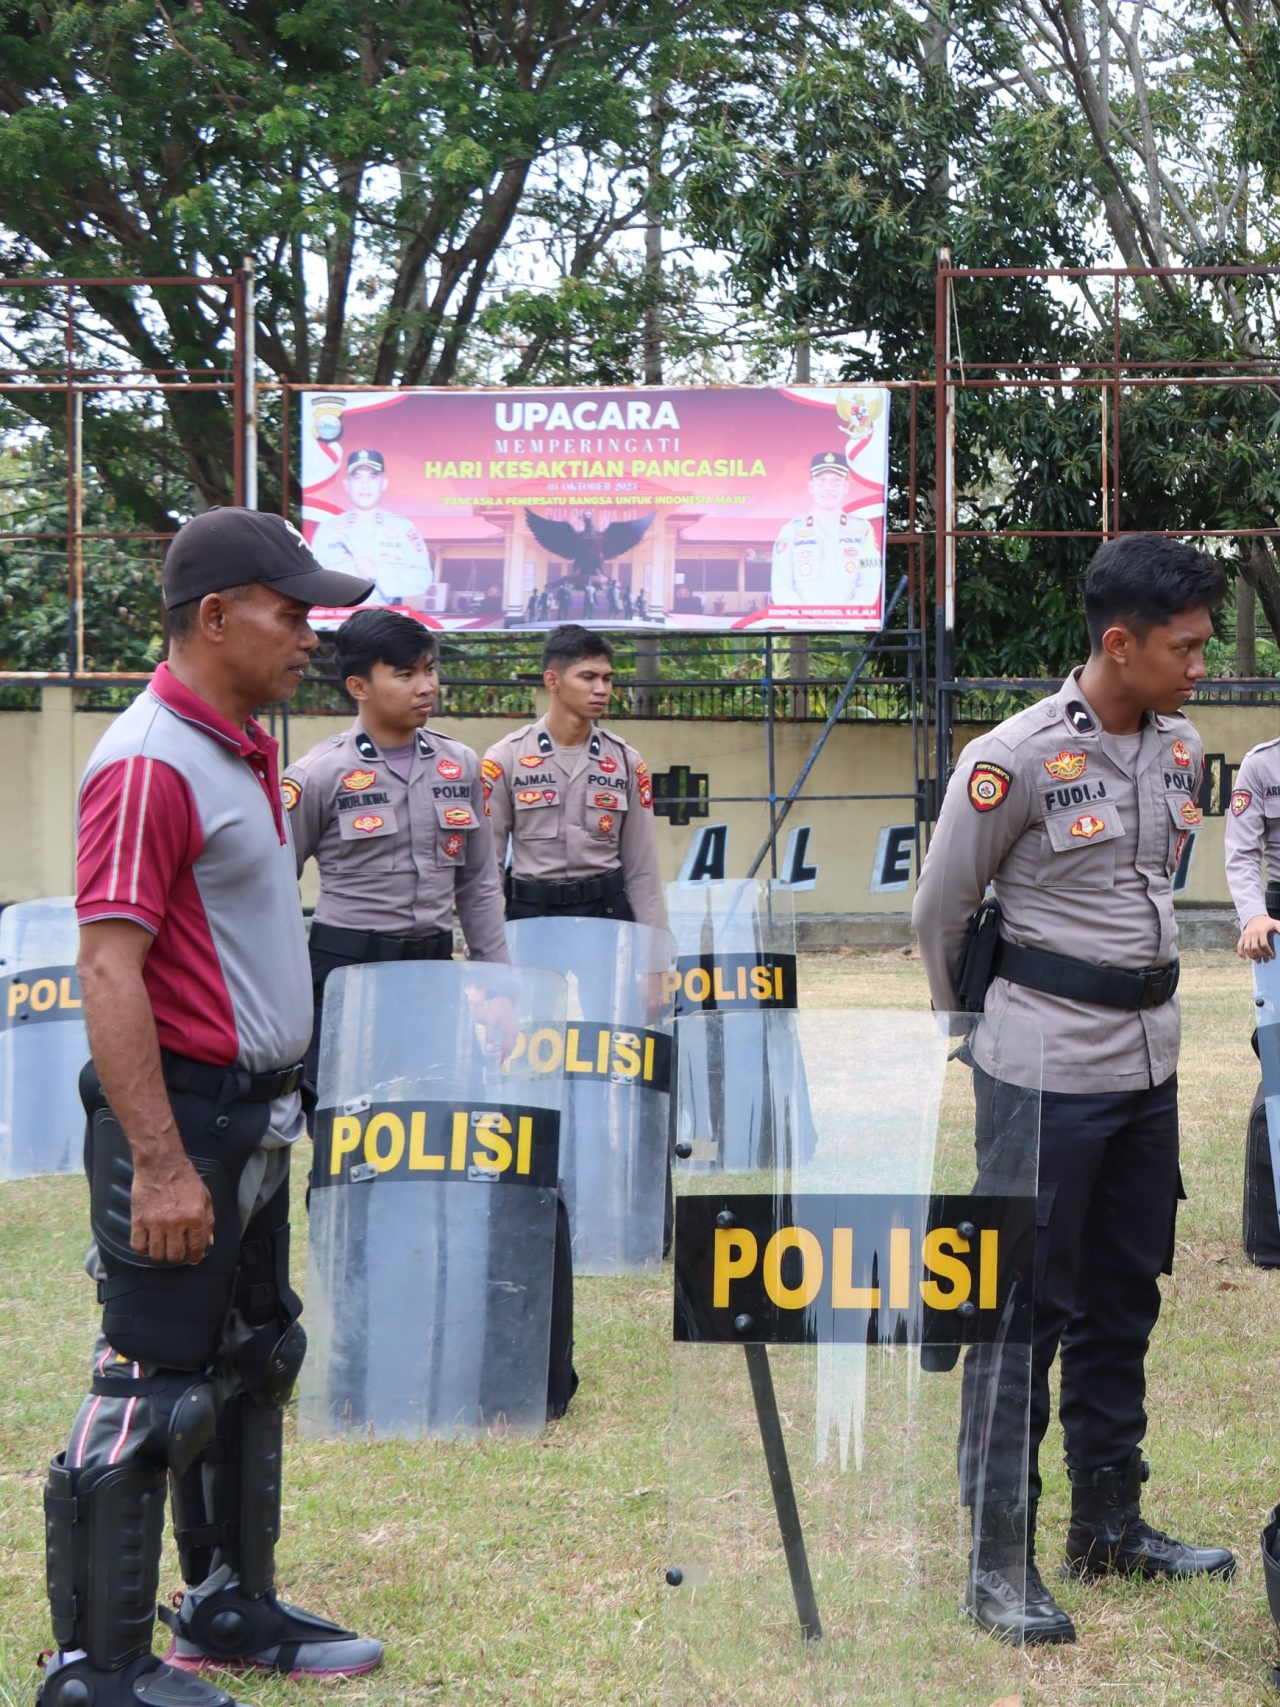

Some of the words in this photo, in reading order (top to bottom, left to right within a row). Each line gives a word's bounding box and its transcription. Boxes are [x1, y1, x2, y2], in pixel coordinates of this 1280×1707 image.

[494, 400, 681, 432] UPACARA
[494, 437, 681, 454] MEMPERINGATI
[424, 461, 483, 479] HARI
[489, 459, 624, 479] KESAKTIAN
[631, 459, 767, 478] PANCASILA
[506, 495, 567, 506] PEMERSATU
[569, 495, 613, 506] BANGSA
[615, 495, 652, 506] UNTUK
[655, 495, 712, 506] INDONESIA
[432, 785, 471, 799] POLRI
[513, 773, 557, 787] AJMAL
[1044, 780, 1107, 811] FUDI.J
[663, 965, 784, 1003] POLISI
[503, 1028, 655, 1081] POLISI
[330, 1110, 533, 1176] POLISI
[713, 1226, 999, 1310] POLISI
